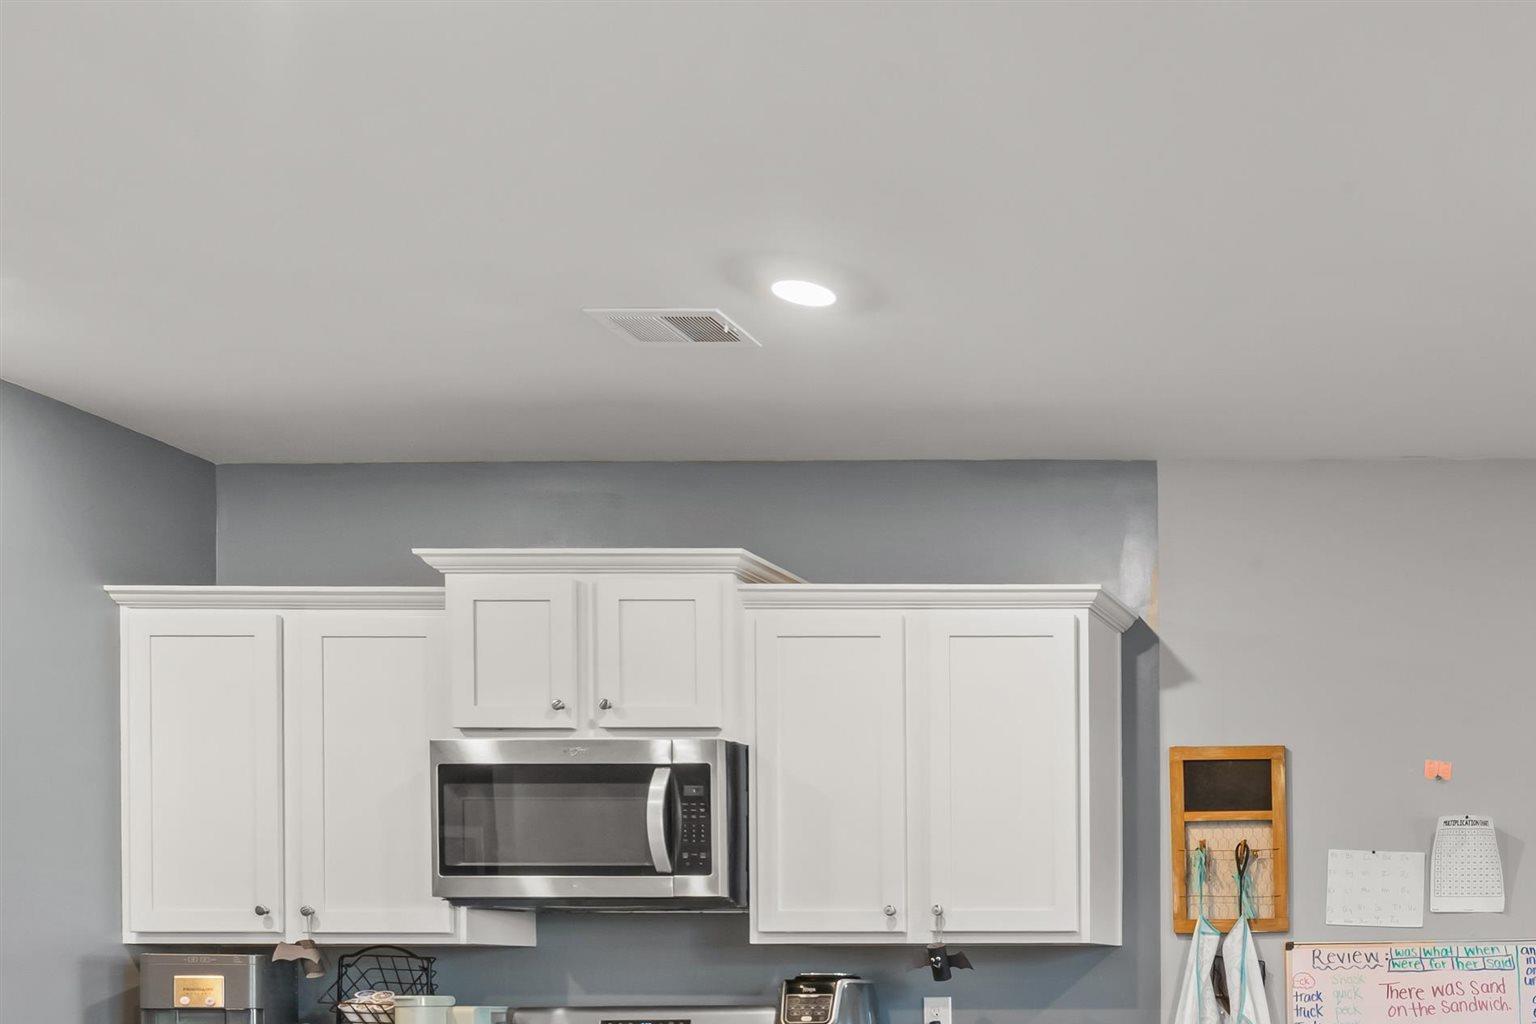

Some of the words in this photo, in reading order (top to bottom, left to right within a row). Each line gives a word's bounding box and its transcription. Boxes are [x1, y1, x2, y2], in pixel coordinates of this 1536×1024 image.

[1394, 946, 1417, 957] was
[1463, 945, 1500, 957] when
[1391, 958, 1421, 969] were
[1429, 958, 1447, 969] for
[1456, 956, 1478, 970] her
[1293, 990, 1324, 1003] track
[1379, 981, 1425, 1000] There
[1431, 981, 1465, 998] was
[1294, 1003, 1324, 1019] truck
[1388, 1004, 1408, 1018] on
[1409, 1001, 1436, 1018] the
